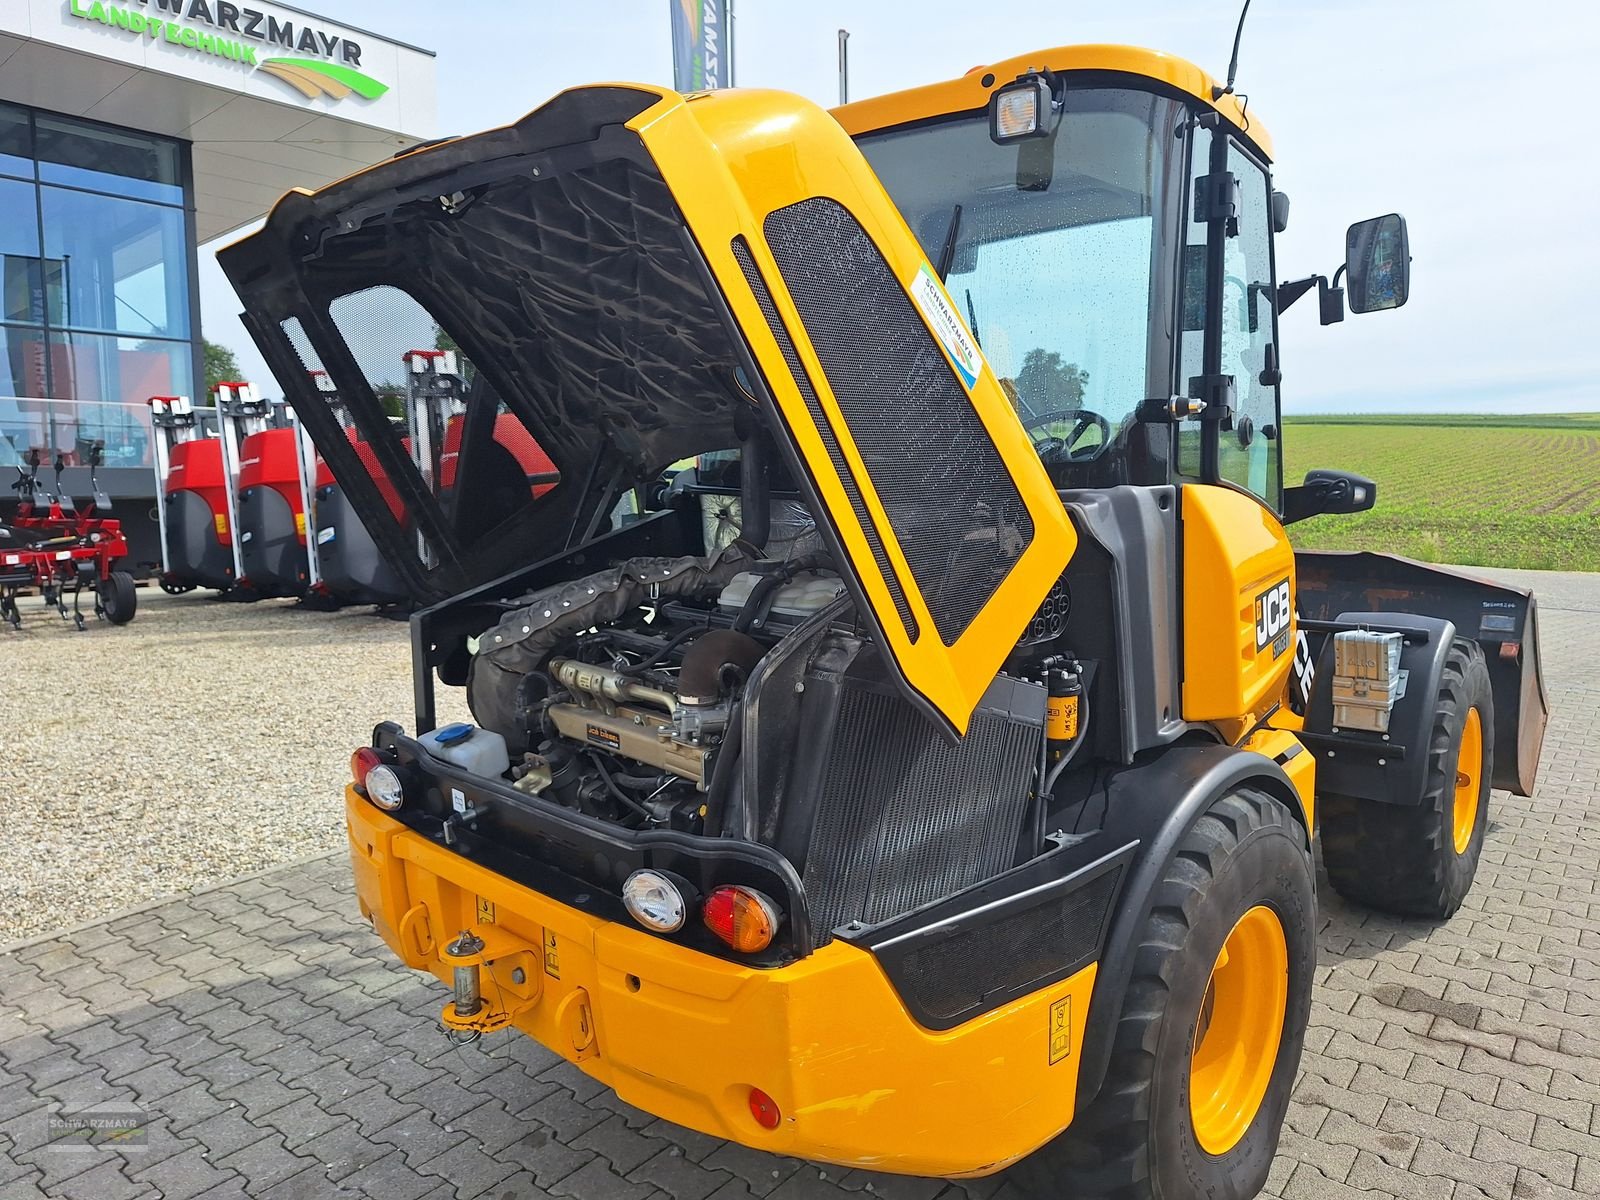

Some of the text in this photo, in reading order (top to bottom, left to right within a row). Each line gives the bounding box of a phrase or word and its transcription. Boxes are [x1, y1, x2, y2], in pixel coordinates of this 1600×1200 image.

[70, 0, 258, 65] LANDTECHNIK
[139, 0, 362, 66] WARZMAYR
[924, 278, 973, 360] SCHWARZMAYR
[1257, 581, 1290, 646] JCB
